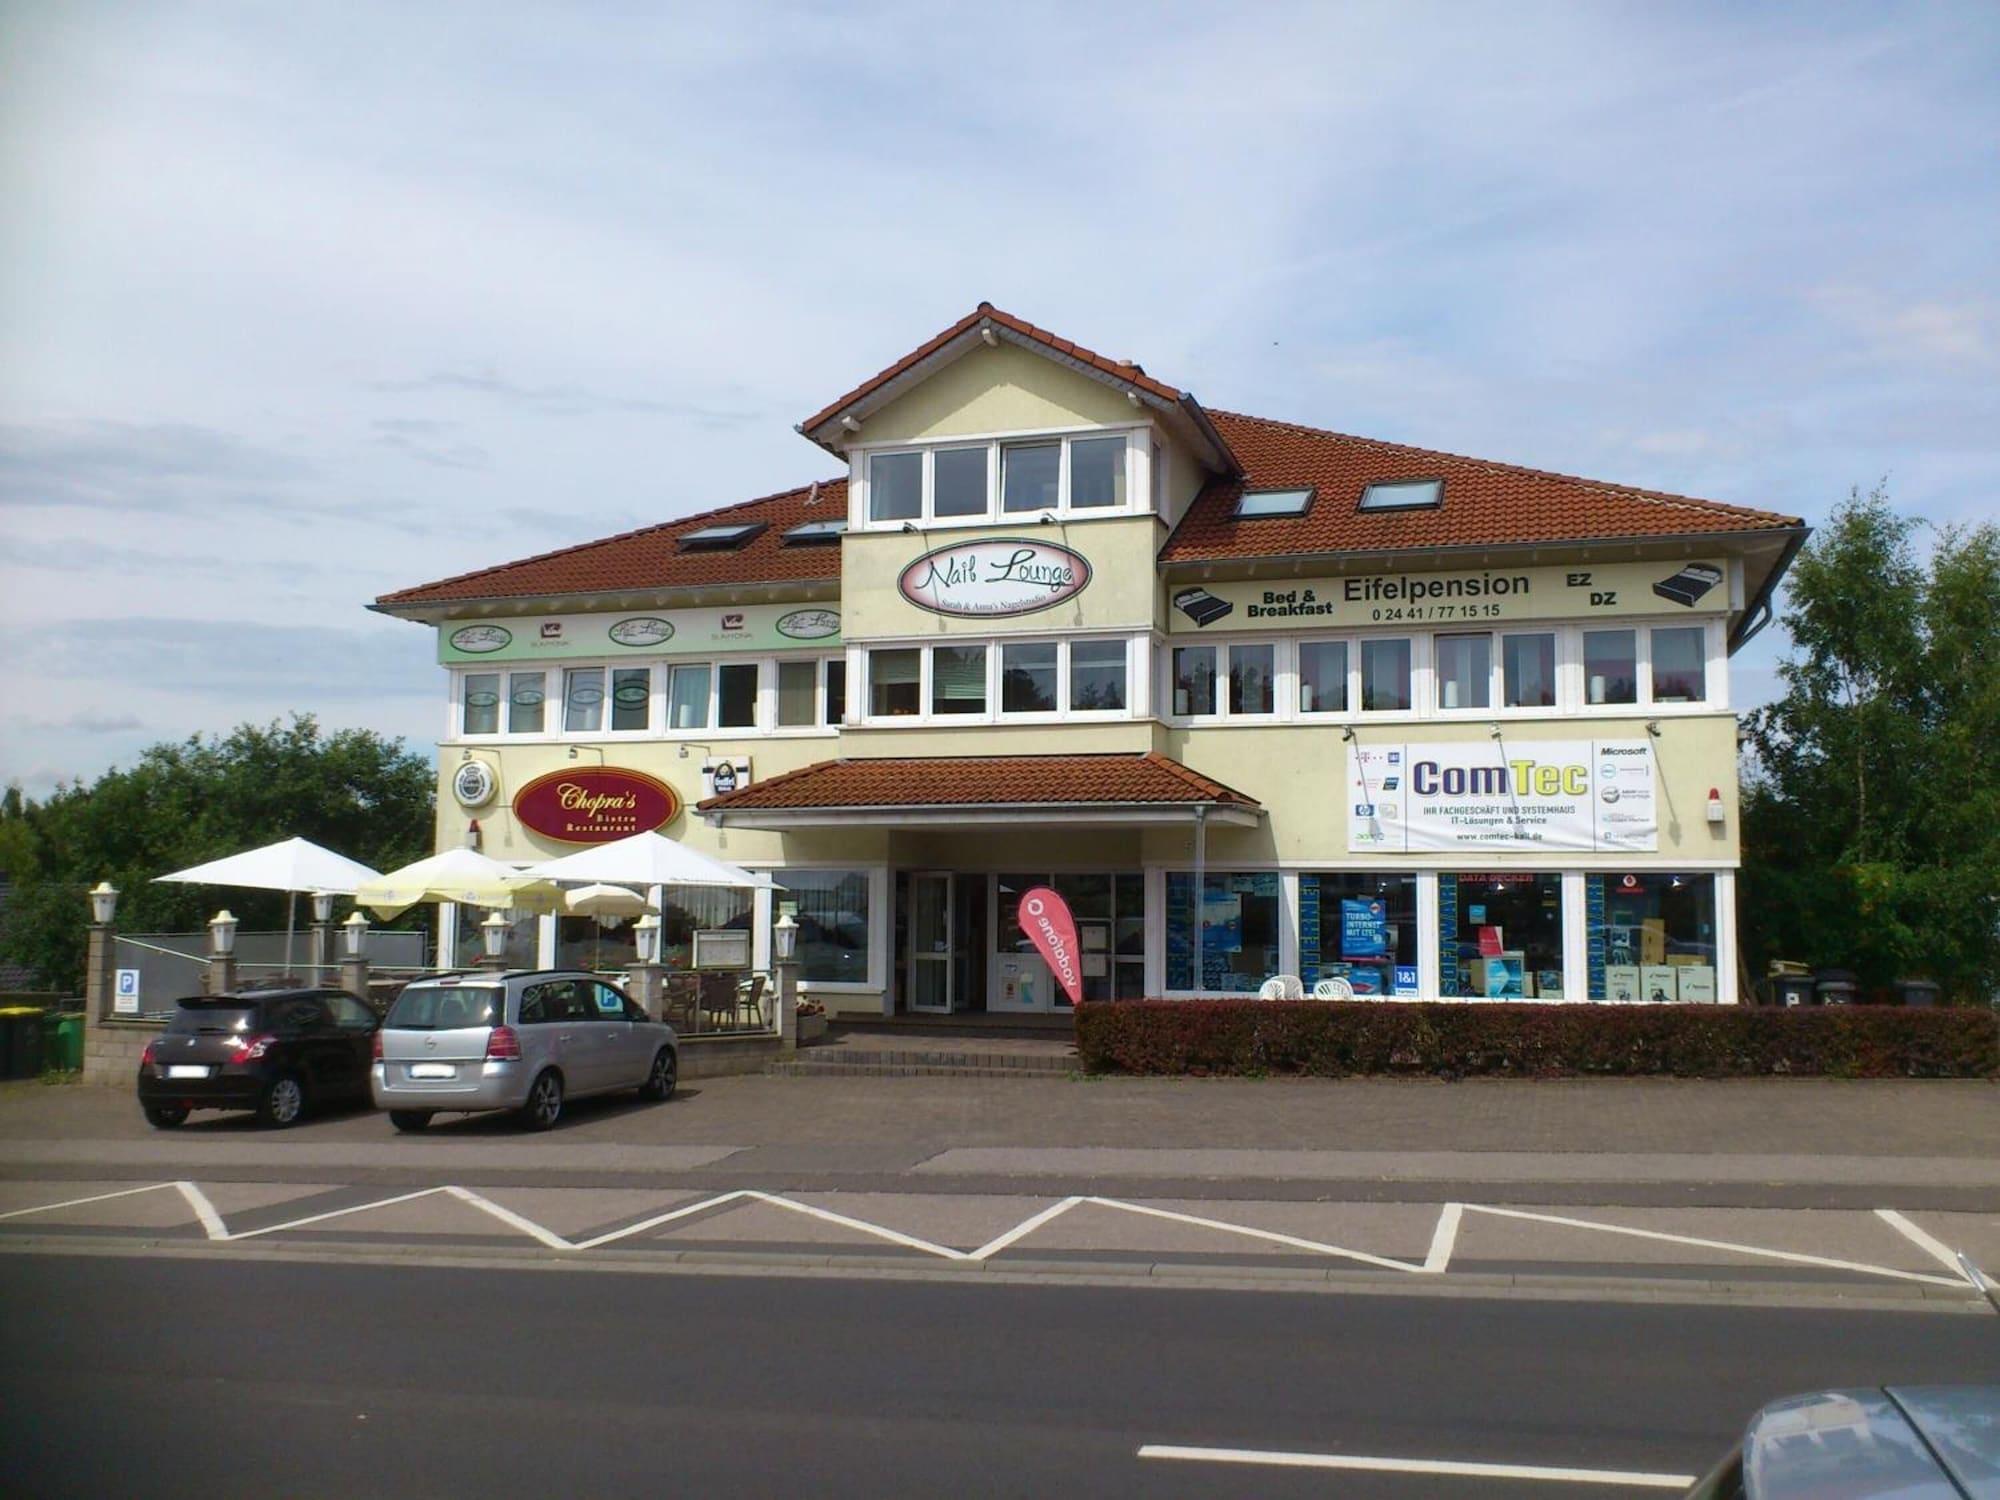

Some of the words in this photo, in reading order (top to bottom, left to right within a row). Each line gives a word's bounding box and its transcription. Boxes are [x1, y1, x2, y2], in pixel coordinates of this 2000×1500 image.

[914, 555, 976, 588] Nail
[984, 549, 1075, 592] Lounge
[1567, 573, 1592, 587] EZ
[1344, 573, 1530, 604] Eifelpension
[1263, 590, 1297, 604] Bed
[1303, 590, 1316, 602] &
[1590, 592, 1617, 606] DZ
[1247, 602, 1333, 617] Breakfast
[1372, 609, 1381, 621] 0
[1385, 608, 1402, 620] 24
[1407, 607, 1423, 619] 41
[1438, 606, 1455, 618] 77
[1461, 605, 1477, 617] 15
[1483, 604, 1500, 616] 15
[1601, 747, 1647, 755] Microsoft
[1413, 760, 1588, 797] ComTec
[556, 783, 636, 817] Chopra's
[1423, 806, 1437, 816] IHR
[1439, 804, 1500, 816] FACHGESCHÄFT
[1502, 806, 1519, 815] UND
[1521, 805, 1576, 815] SYSTEMHAUS
[597, 814, 636, 822] Bistro
[1451, 816, 1504, 826] IT-Lösungen
[1506, 816, 1513, 825] &
[1515, 815, 1547, 825] Service
[566, 823, 636, 831] Restaurant
[1439, 875, 1458, 995] SOFTWARE
[1586, 875, 1606, 1000] HARDWARE
[122, 975, 132, 991] P
[1397, 971, 1415, 984] 1&1
